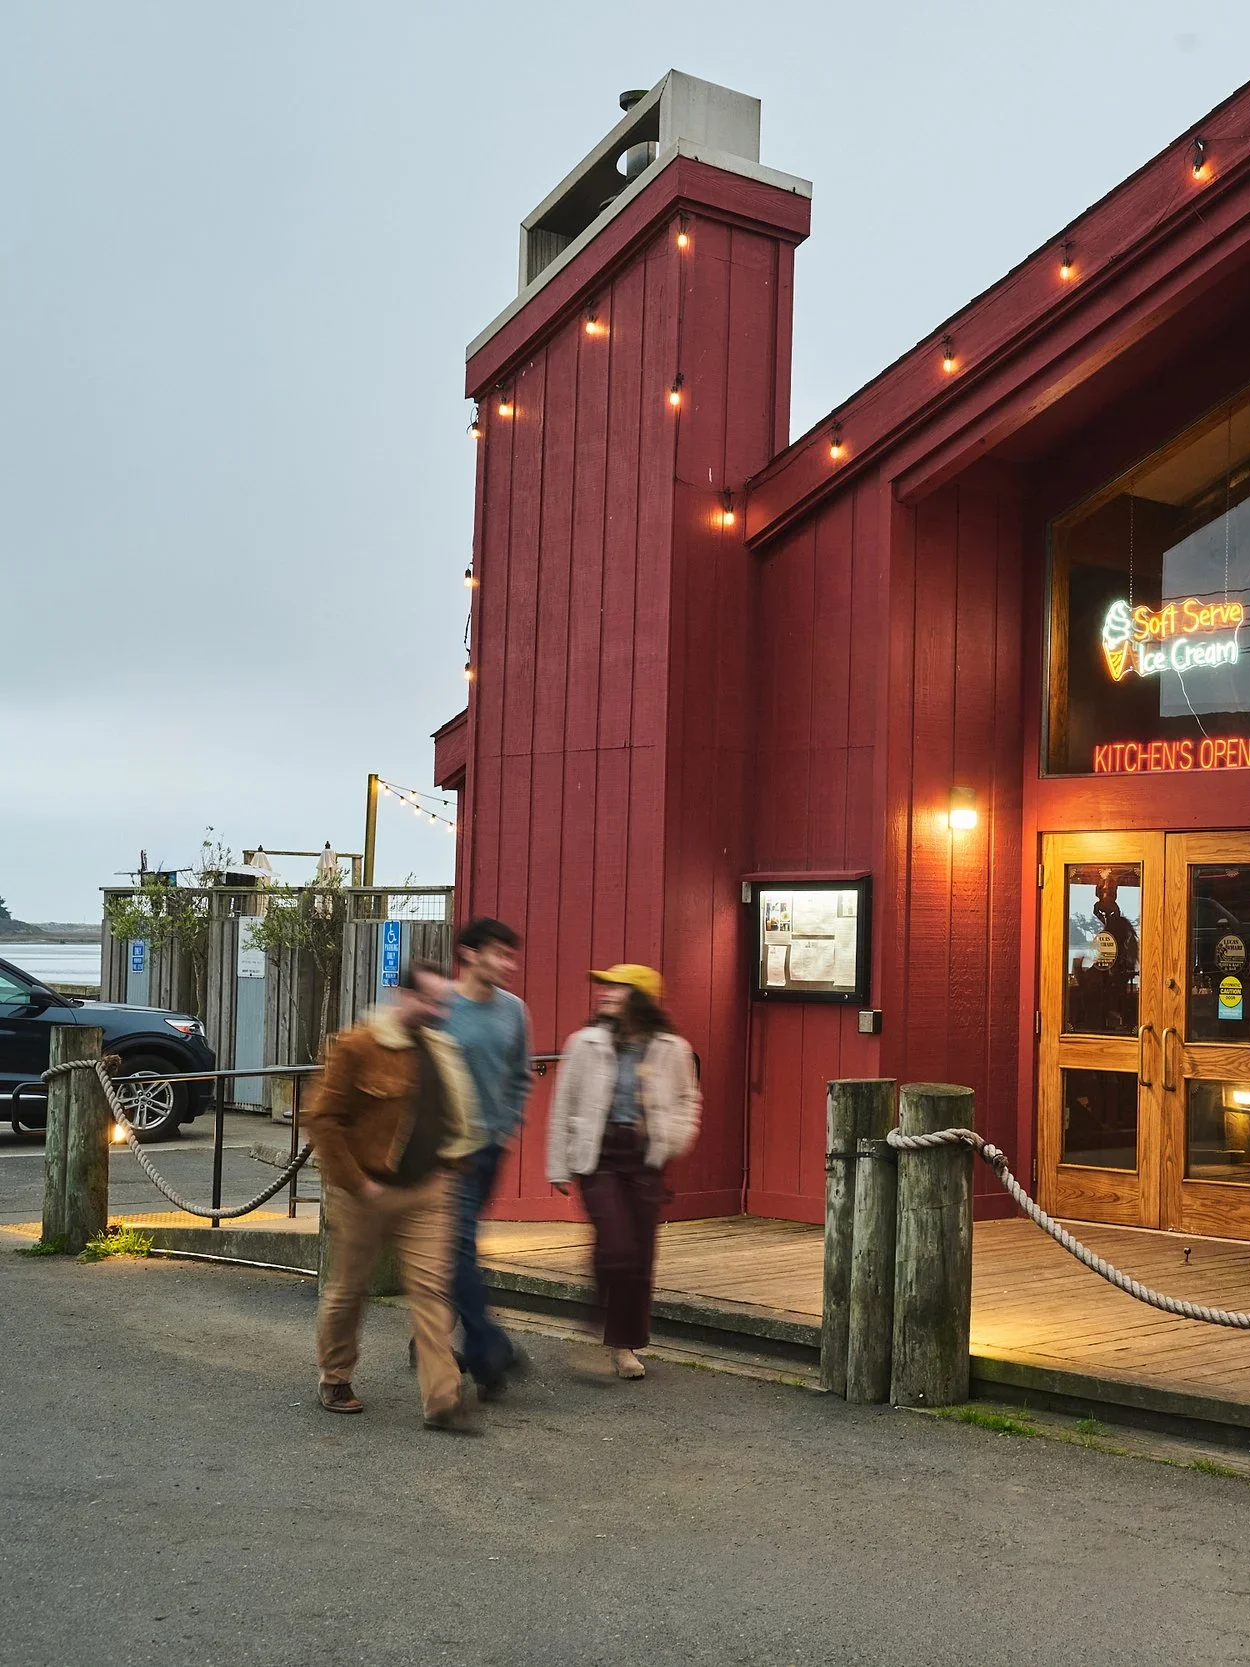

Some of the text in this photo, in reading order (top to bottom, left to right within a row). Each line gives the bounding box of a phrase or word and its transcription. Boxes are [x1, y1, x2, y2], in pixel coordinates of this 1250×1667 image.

[1134, 599, 1242, 640] Soft Serve
[1139, 637, 1237, 674] Ice Cream
[1095, 740, 1193, 773] KITCHEN'S
